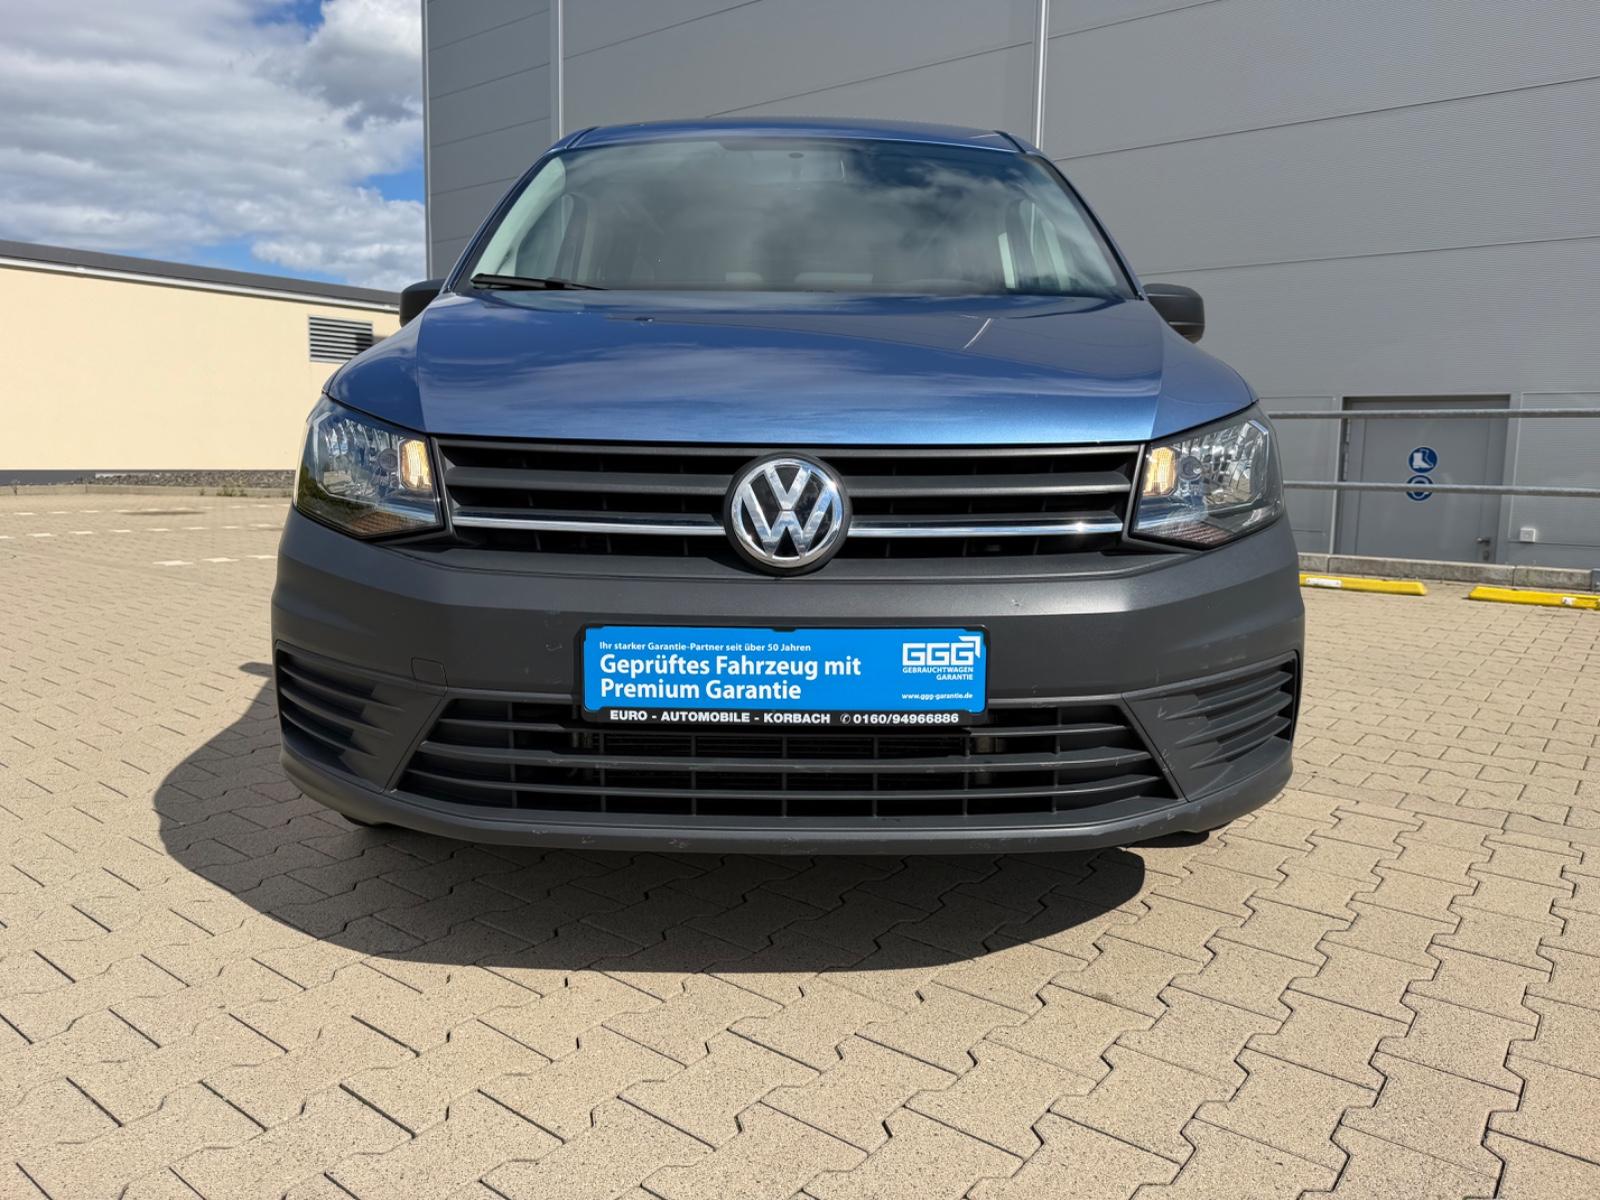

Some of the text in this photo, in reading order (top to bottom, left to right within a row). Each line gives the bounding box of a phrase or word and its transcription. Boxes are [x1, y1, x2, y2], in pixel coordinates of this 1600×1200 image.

[600, 641, 811, 651] Ihr starker Garantie-Partner seit über 50 Jahren
[902, 643, 974, 666] GGG
[600, 654, 861, 680] Geprüftes Fahrzeug mit
[601, 678, 801, 699] Premium Garantie
[610, 710, 647, 720] EURO
[661, 711, 750, 722] AUTOMOBILE
[764, 712, 831, 723] KORBACH
[853, 713, 959, 724] 0160/94966886
